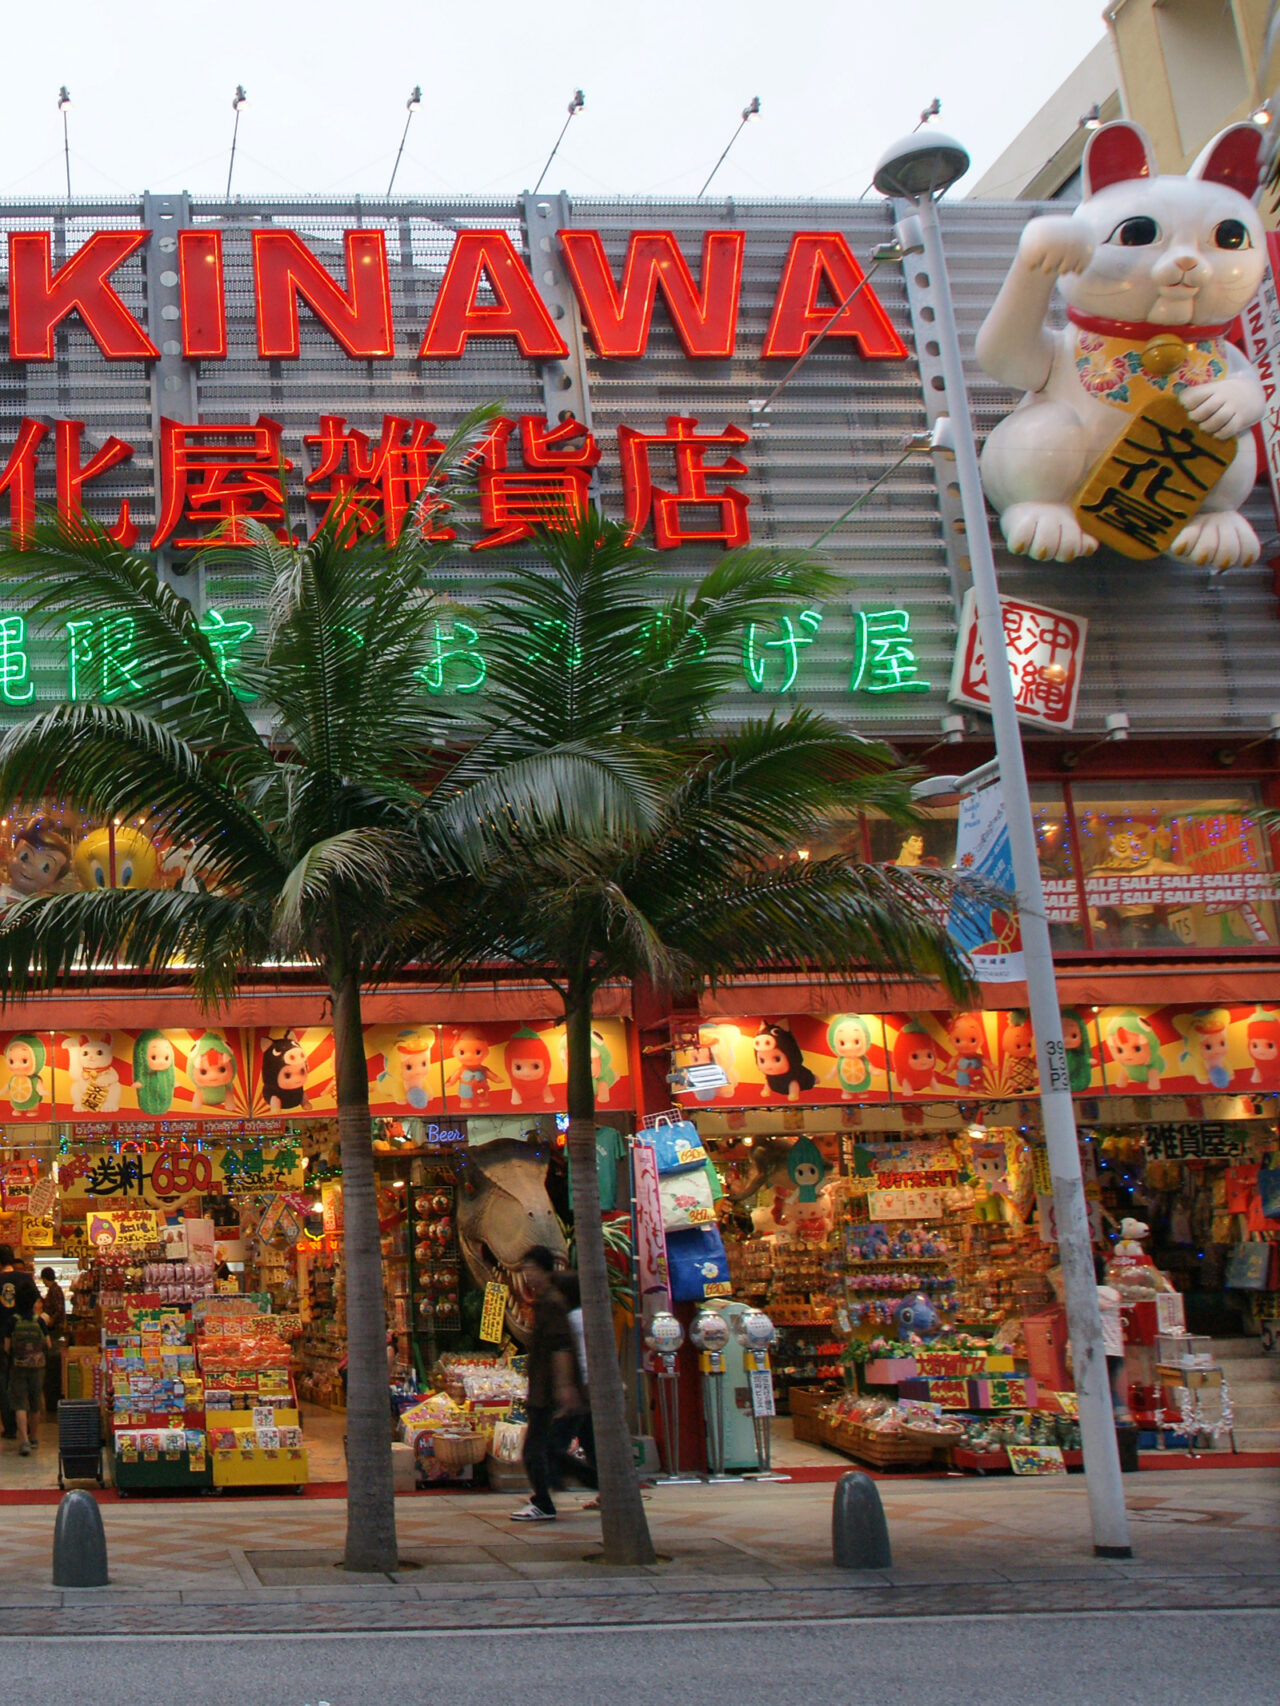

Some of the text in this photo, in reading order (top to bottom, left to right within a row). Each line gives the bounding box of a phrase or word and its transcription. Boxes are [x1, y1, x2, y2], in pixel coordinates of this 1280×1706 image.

[1246, 301, 1277, 403] INAWA
[1080, 414, 1230, 553] 文化屋
[1120, 875, 1160, 890] SALE
[1161, 874, 1201, 889] SALE
[1202, 873, 1242, 887] SALE
[1122, 891, 1162, 904] SALE
[1163, 889, 1203, 903] SALE
[1205, 888, 1244, 902] SALE
[1240, 903, 1269, 943] SALE
[427, 1124, 465, 1143] Beer
